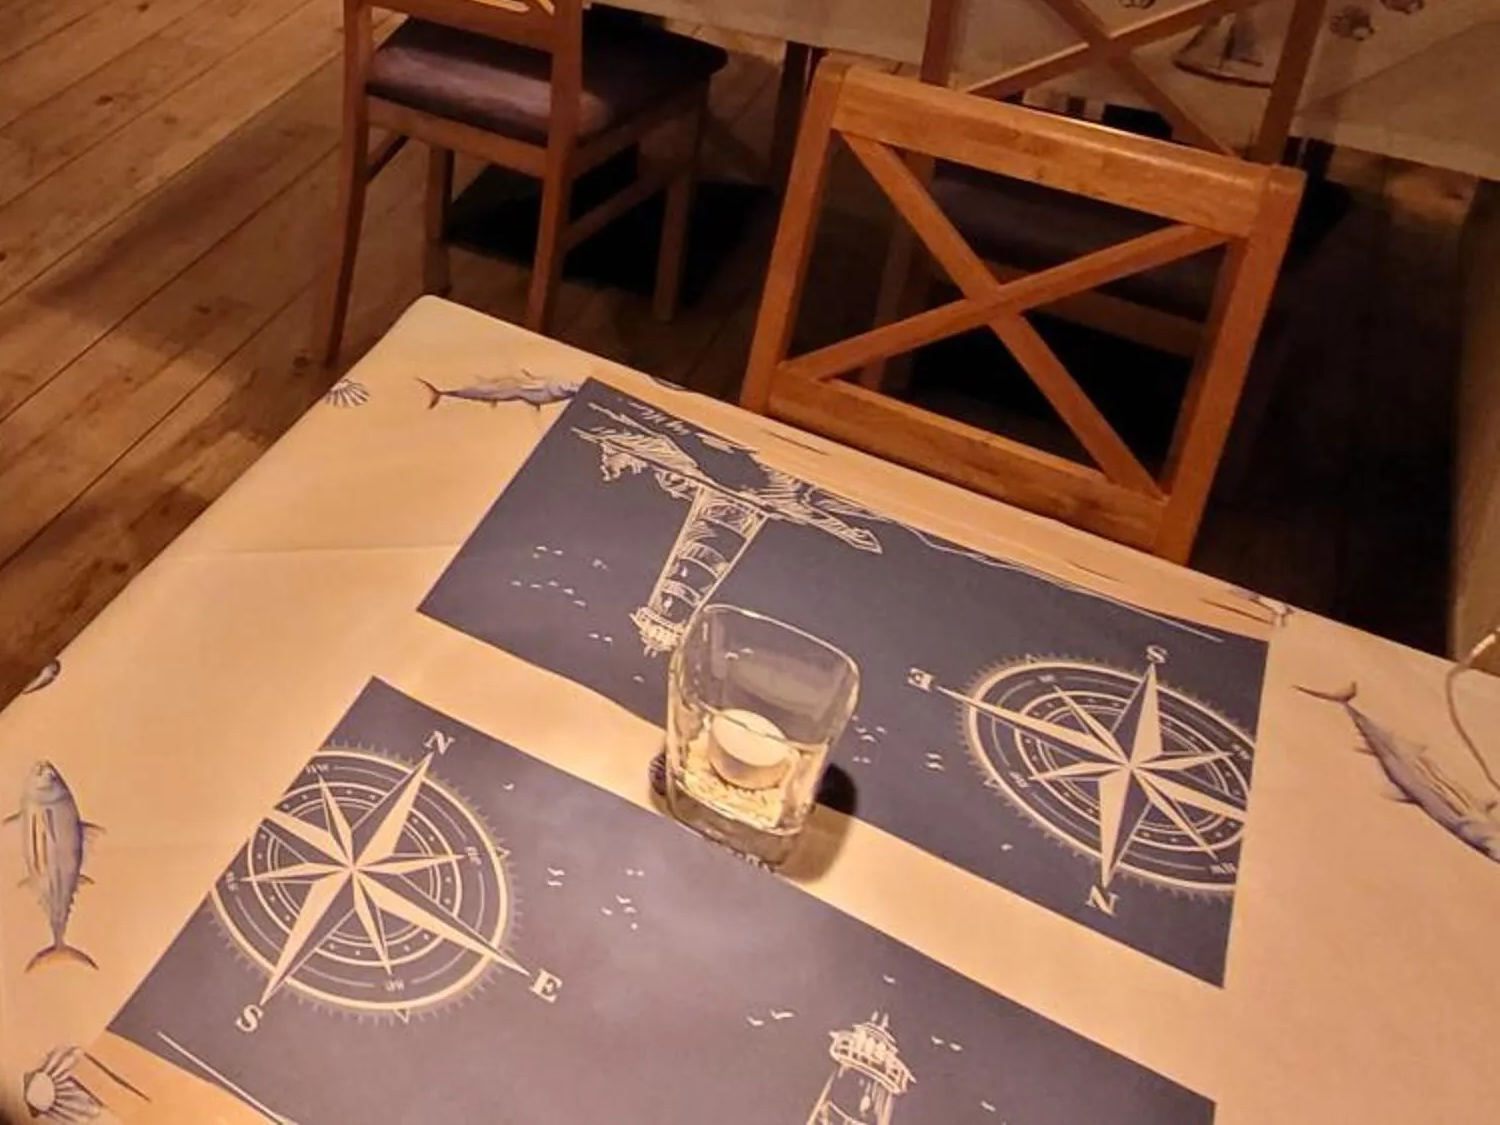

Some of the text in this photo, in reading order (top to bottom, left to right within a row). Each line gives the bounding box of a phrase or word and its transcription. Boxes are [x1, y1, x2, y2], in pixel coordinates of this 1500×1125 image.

[1145, 644, 1168, 665] S
[907, 667, 933, 691] E
[423, 730, 456, 755] N
[1086, 885, 1119, 917] N
[529, 968, 563, 1003] E
[235, 1004, 264, 1032] S
